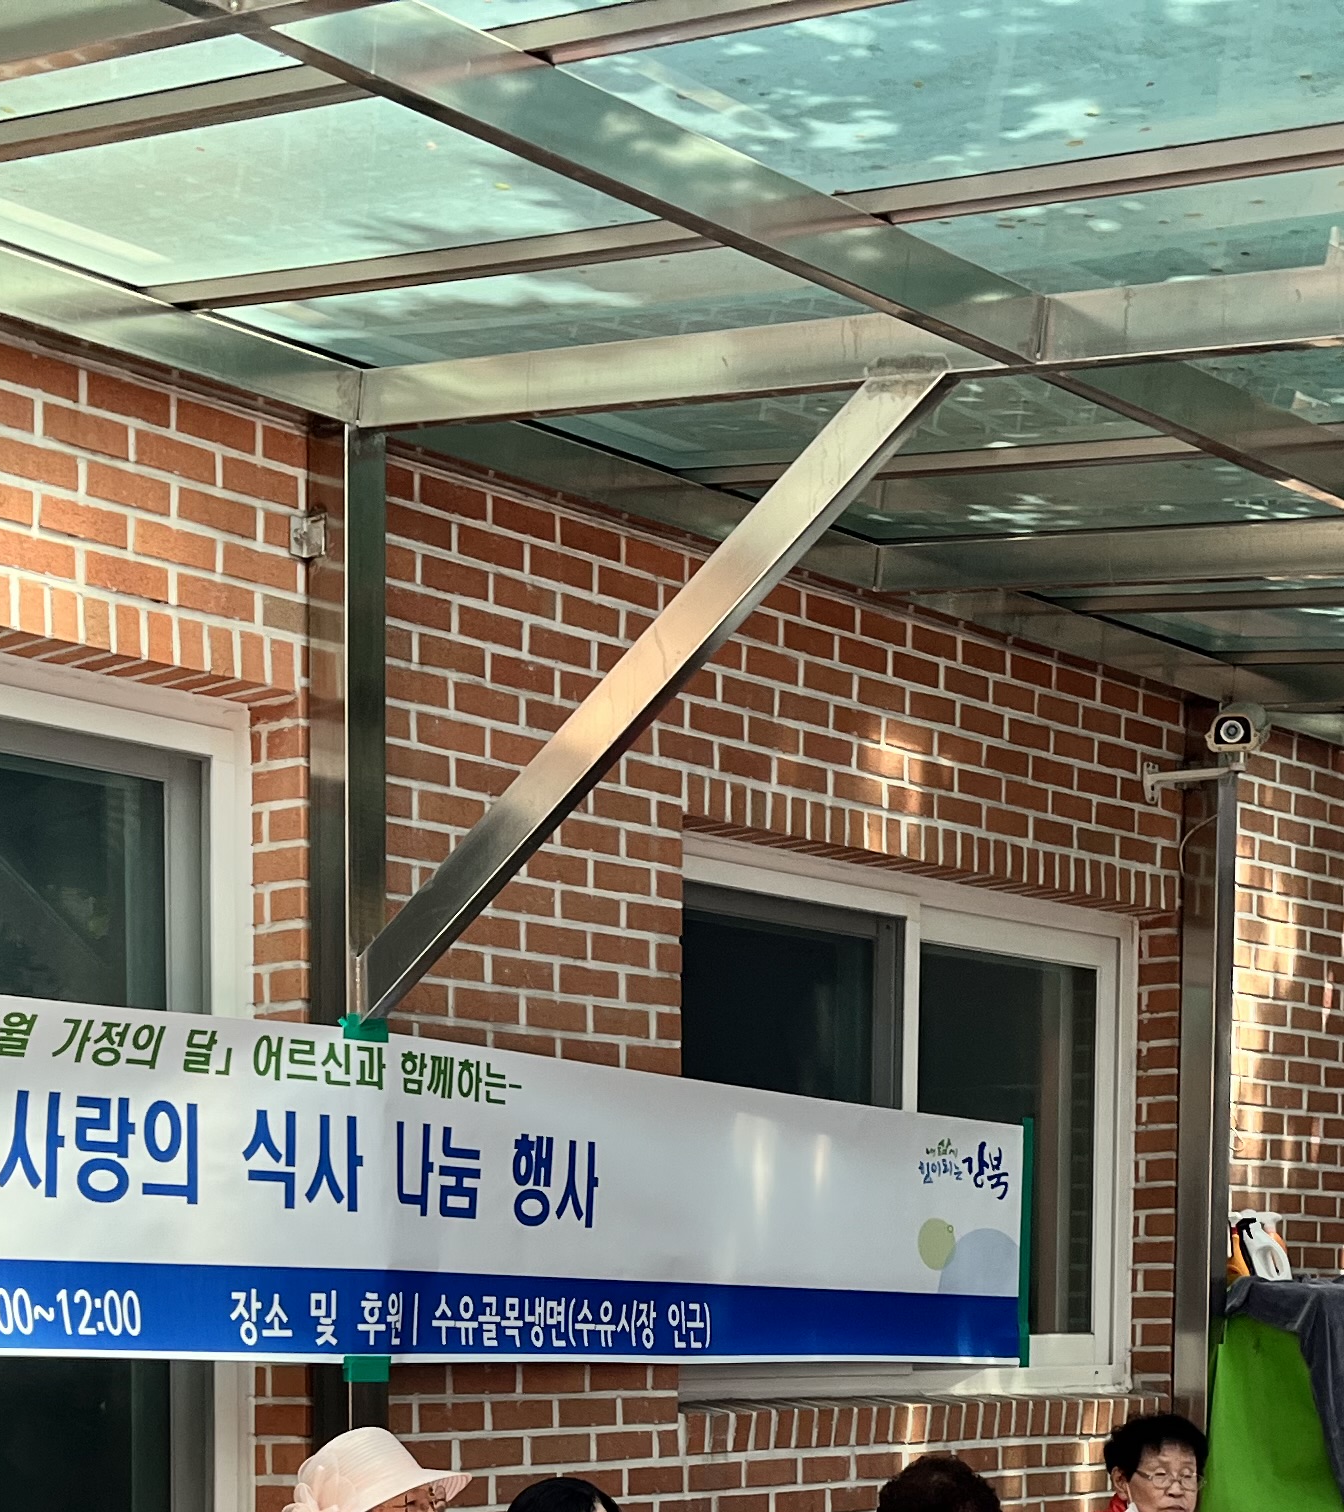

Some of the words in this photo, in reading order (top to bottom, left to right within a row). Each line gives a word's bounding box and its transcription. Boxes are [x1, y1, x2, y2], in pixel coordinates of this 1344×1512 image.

[52, 1017, 167, 1070] 가정의
[253, 1033, 386, 1091] 어르신과
[242, 1109, 364, 1213] 식사
[396, 1120, 482, 1220] 나눔
[511, 1133, 600, 1229] 행사
[962, 1141, 1009, 1200] 강북
[229, 1287, 293, 1346] 장소
[309, 1289, 339, 1346] 및
[357, 1291, 404, 1346] 후원
[667, 1302, 712, 1349] 인근)
